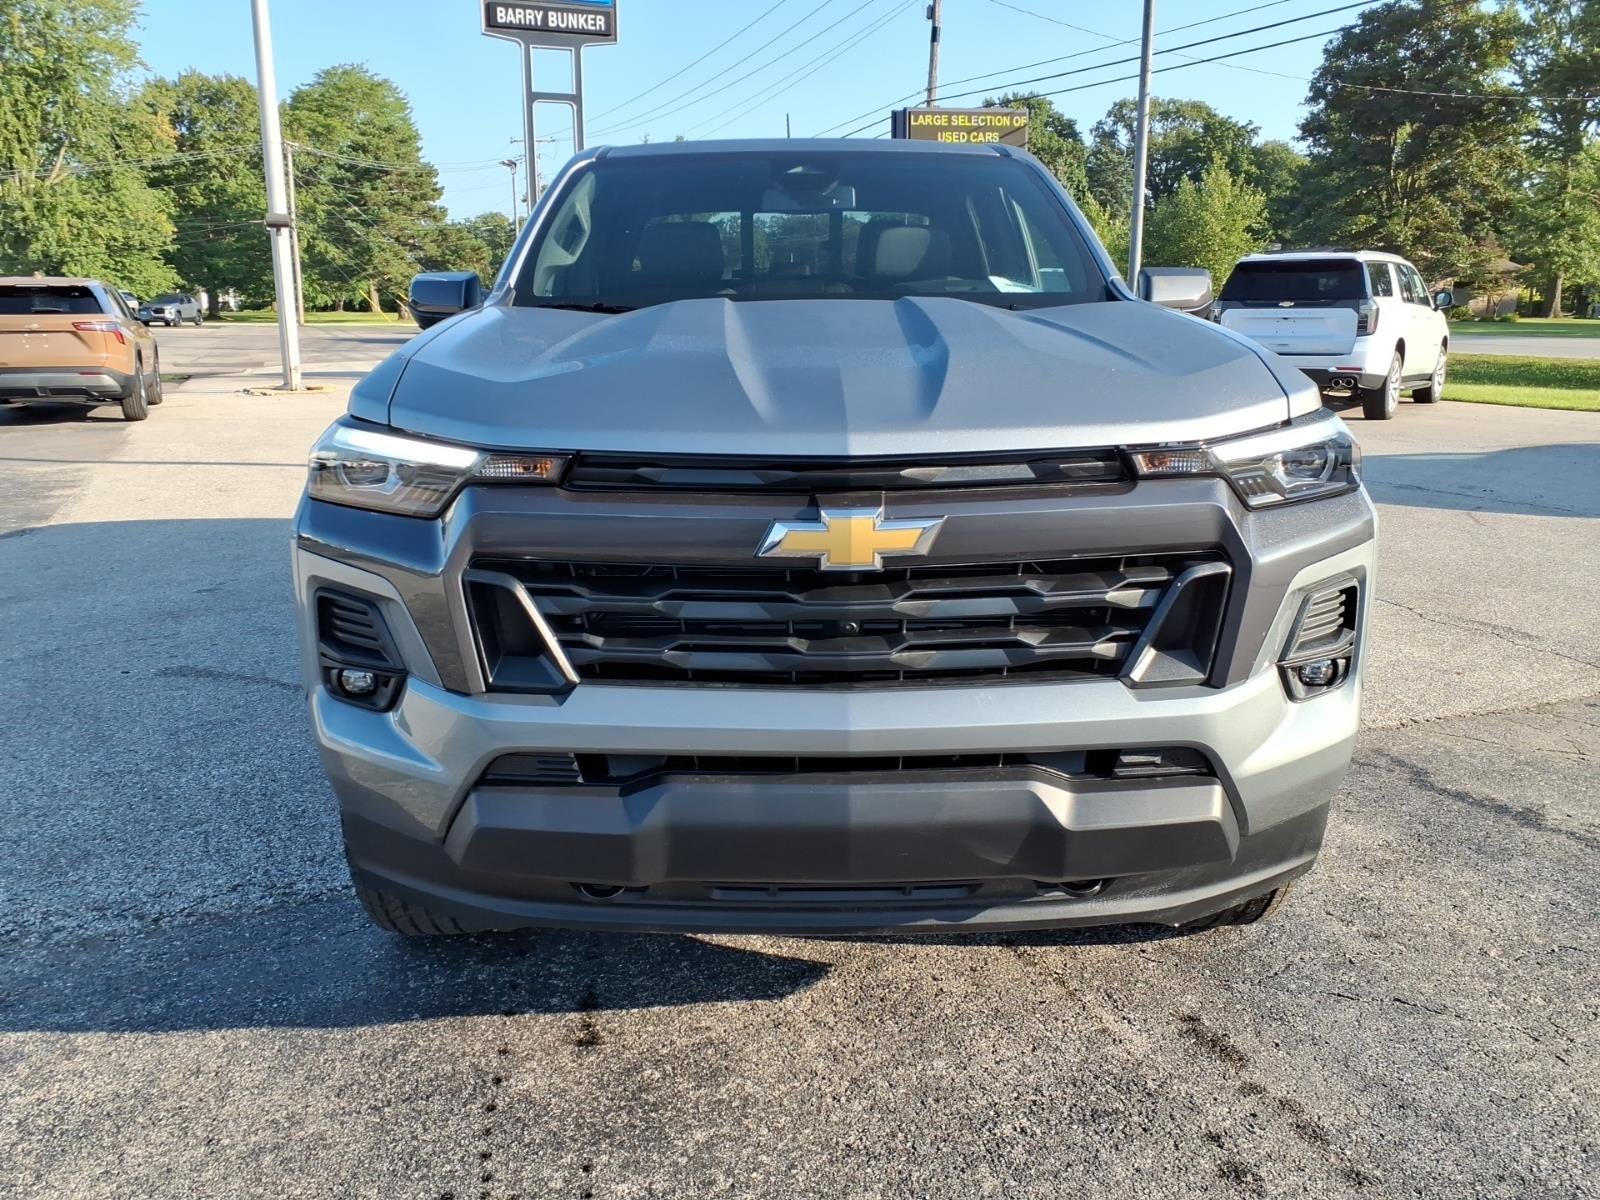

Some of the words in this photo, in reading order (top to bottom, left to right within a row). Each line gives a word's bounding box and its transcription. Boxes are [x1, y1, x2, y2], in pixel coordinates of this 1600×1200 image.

[496, 7, 543, 26] BARRY
[548, 11, 605, 31] BUNKER
[911, 114, 948, 126] LARGE
[951, 115, 1010, 126] SELECTION
[1013, 116, 1027, 126] OF
[938, 132, 967, 143] USED
[970, 132, 999, 143] CARS
